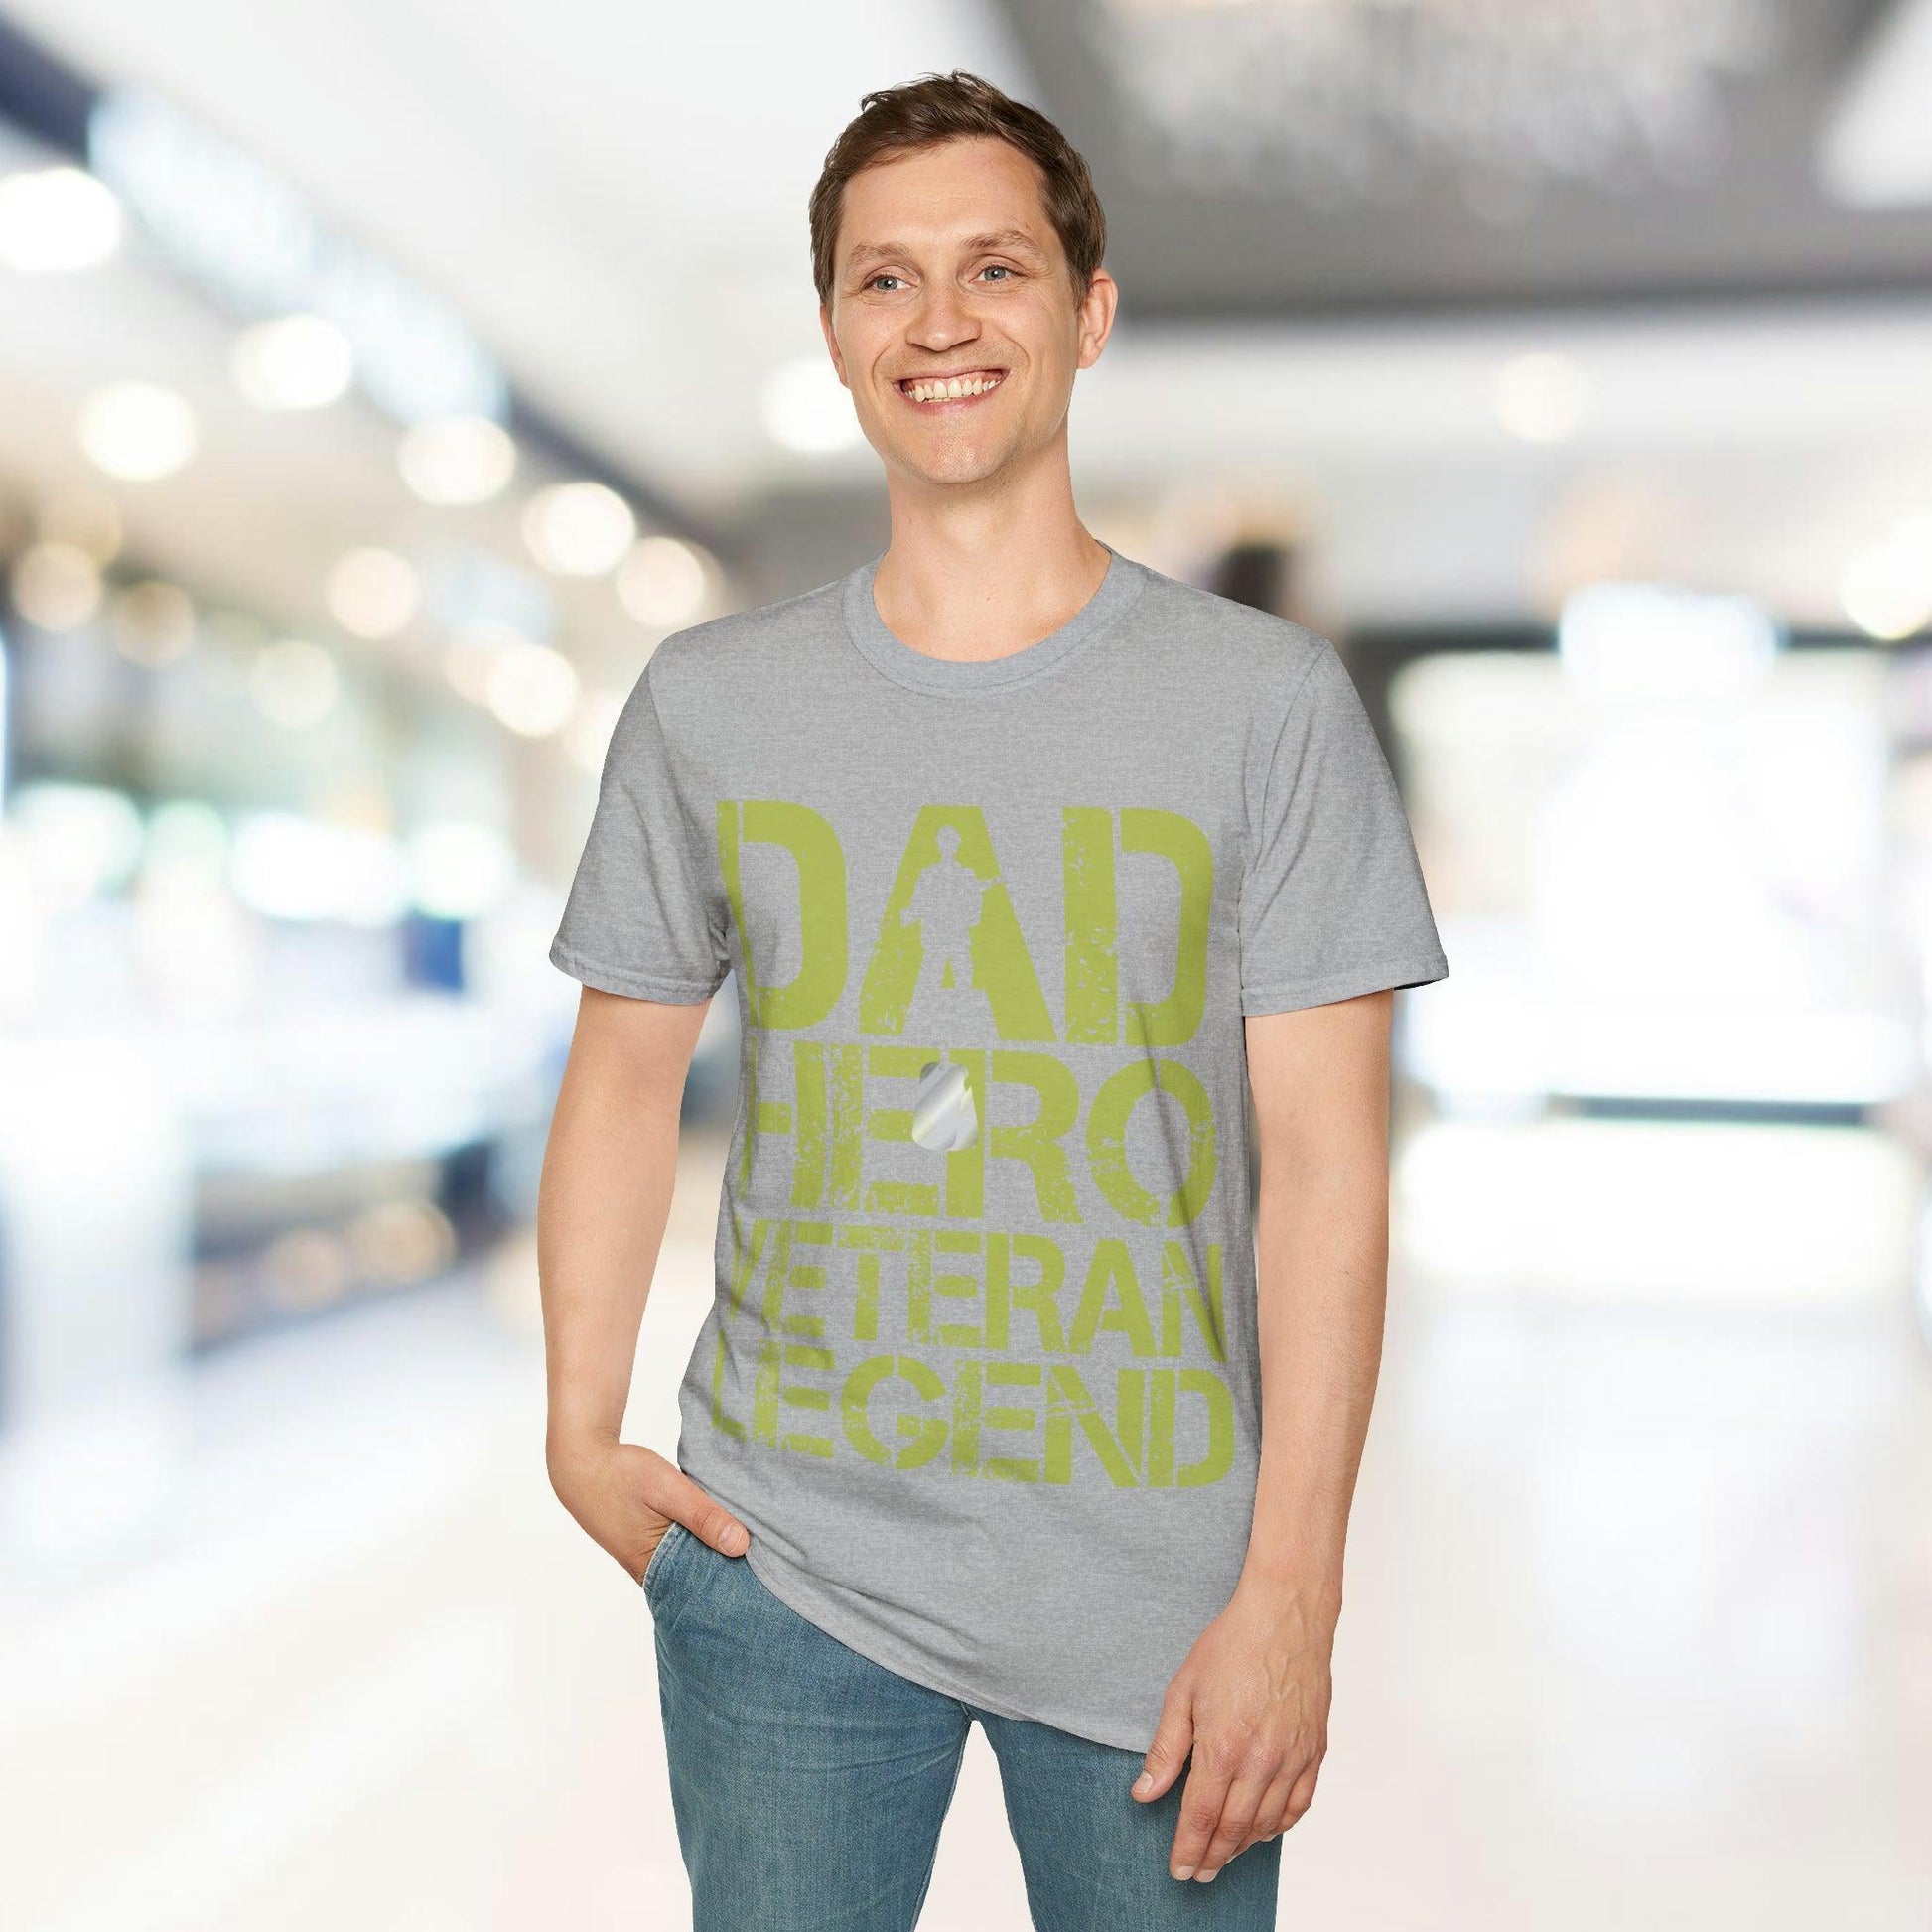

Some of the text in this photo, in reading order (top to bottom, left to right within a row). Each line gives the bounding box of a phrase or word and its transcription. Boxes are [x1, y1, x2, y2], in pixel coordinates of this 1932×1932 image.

[716, 800, 1215, 1047] DAD
[737, 1036, 1217, 1228] HERO
[729, 1217, 1228, 1364] VETERAN
[712, 1329, 1235, 1488] LEGEND
